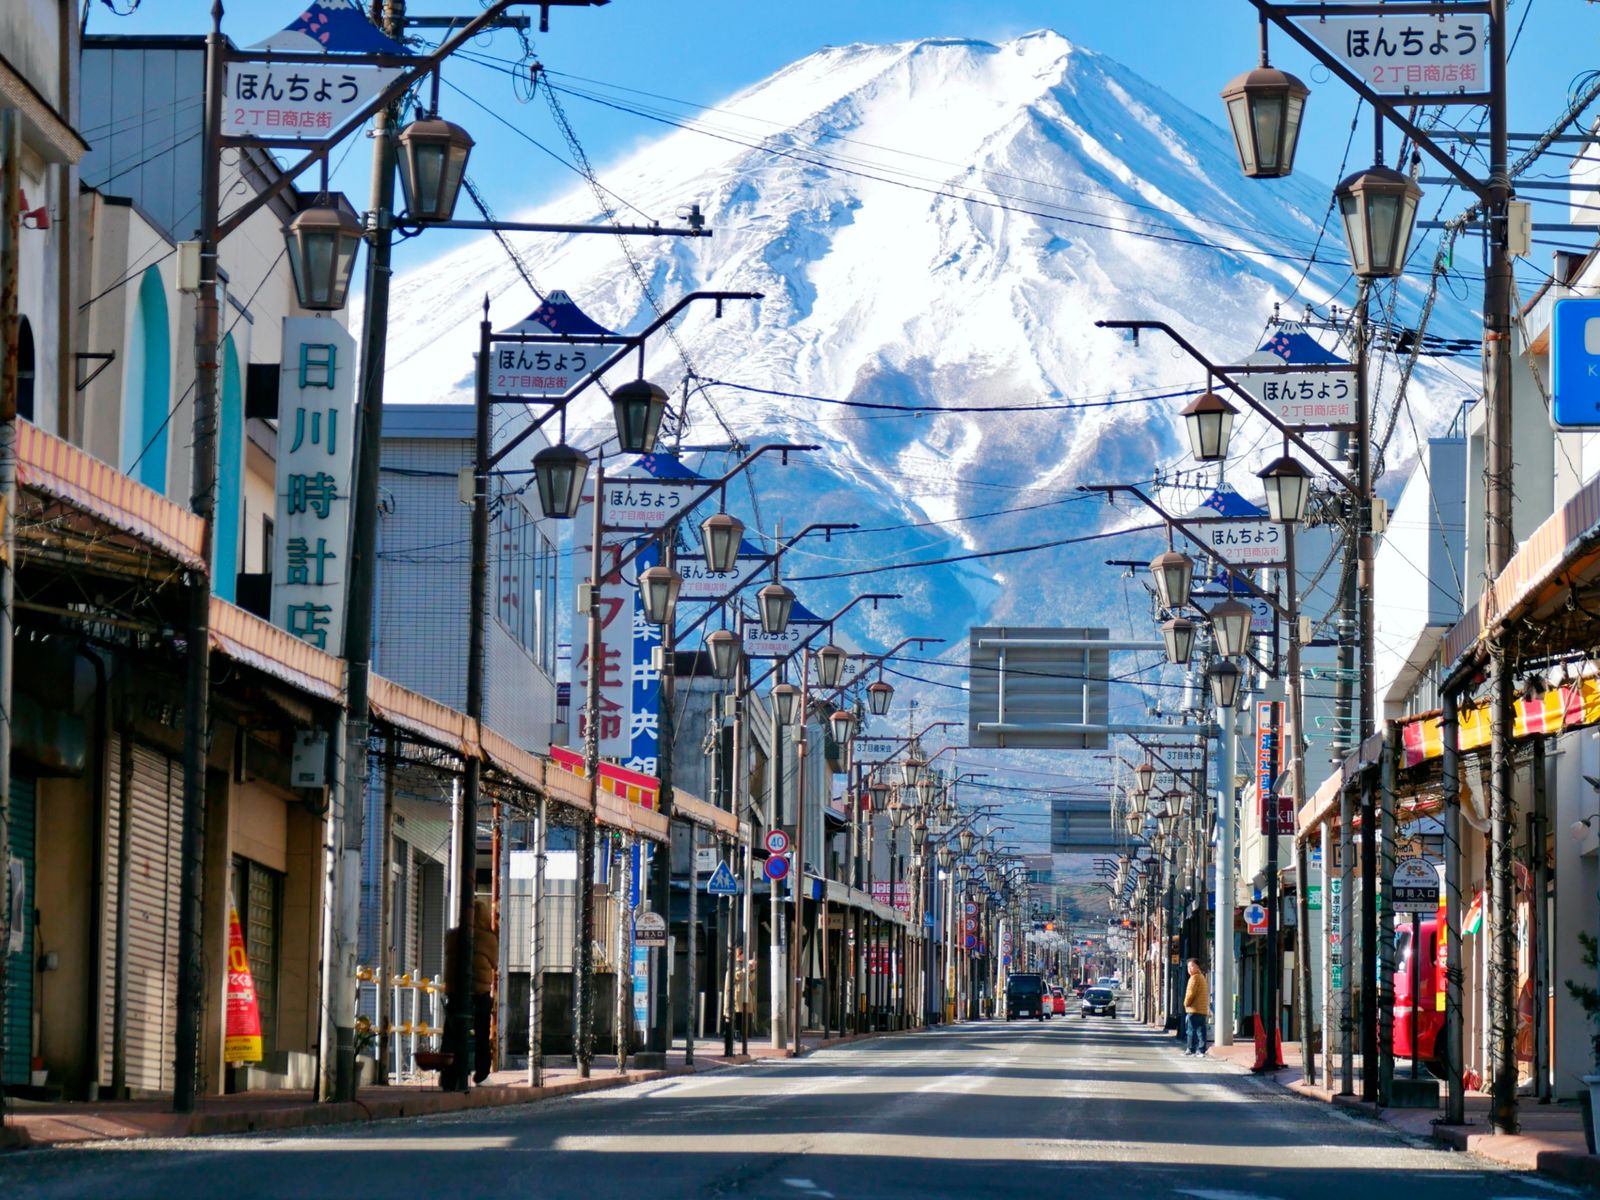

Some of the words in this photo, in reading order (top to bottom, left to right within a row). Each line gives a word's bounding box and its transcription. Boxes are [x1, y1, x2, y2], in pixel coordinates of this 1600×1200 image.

[1346, 24, 1477, 58] ほんちょう
[1372, 63, 1477, 84] 2丁目商店街
[236, 72, 358, 104] ほんちょう
[234, 107, 332, 129] 2丁目商店街
[498, 349, 587, 372] ほんちょう
[497, 374, 568, 389] 2丁目商店街
[1263, 378, 1349, 401] ほんちょう
[1281, 403, 1349, 417] 2丁目商店街
[287, 342, 338, 650] 日川時計店
[610, 490, 680, 508] ほんちょう
[1212, 527, 1279, 545] ほんちょう
[770, 837, 784, 847] 40
[1395, 888, 1436, 898] 明見入口
